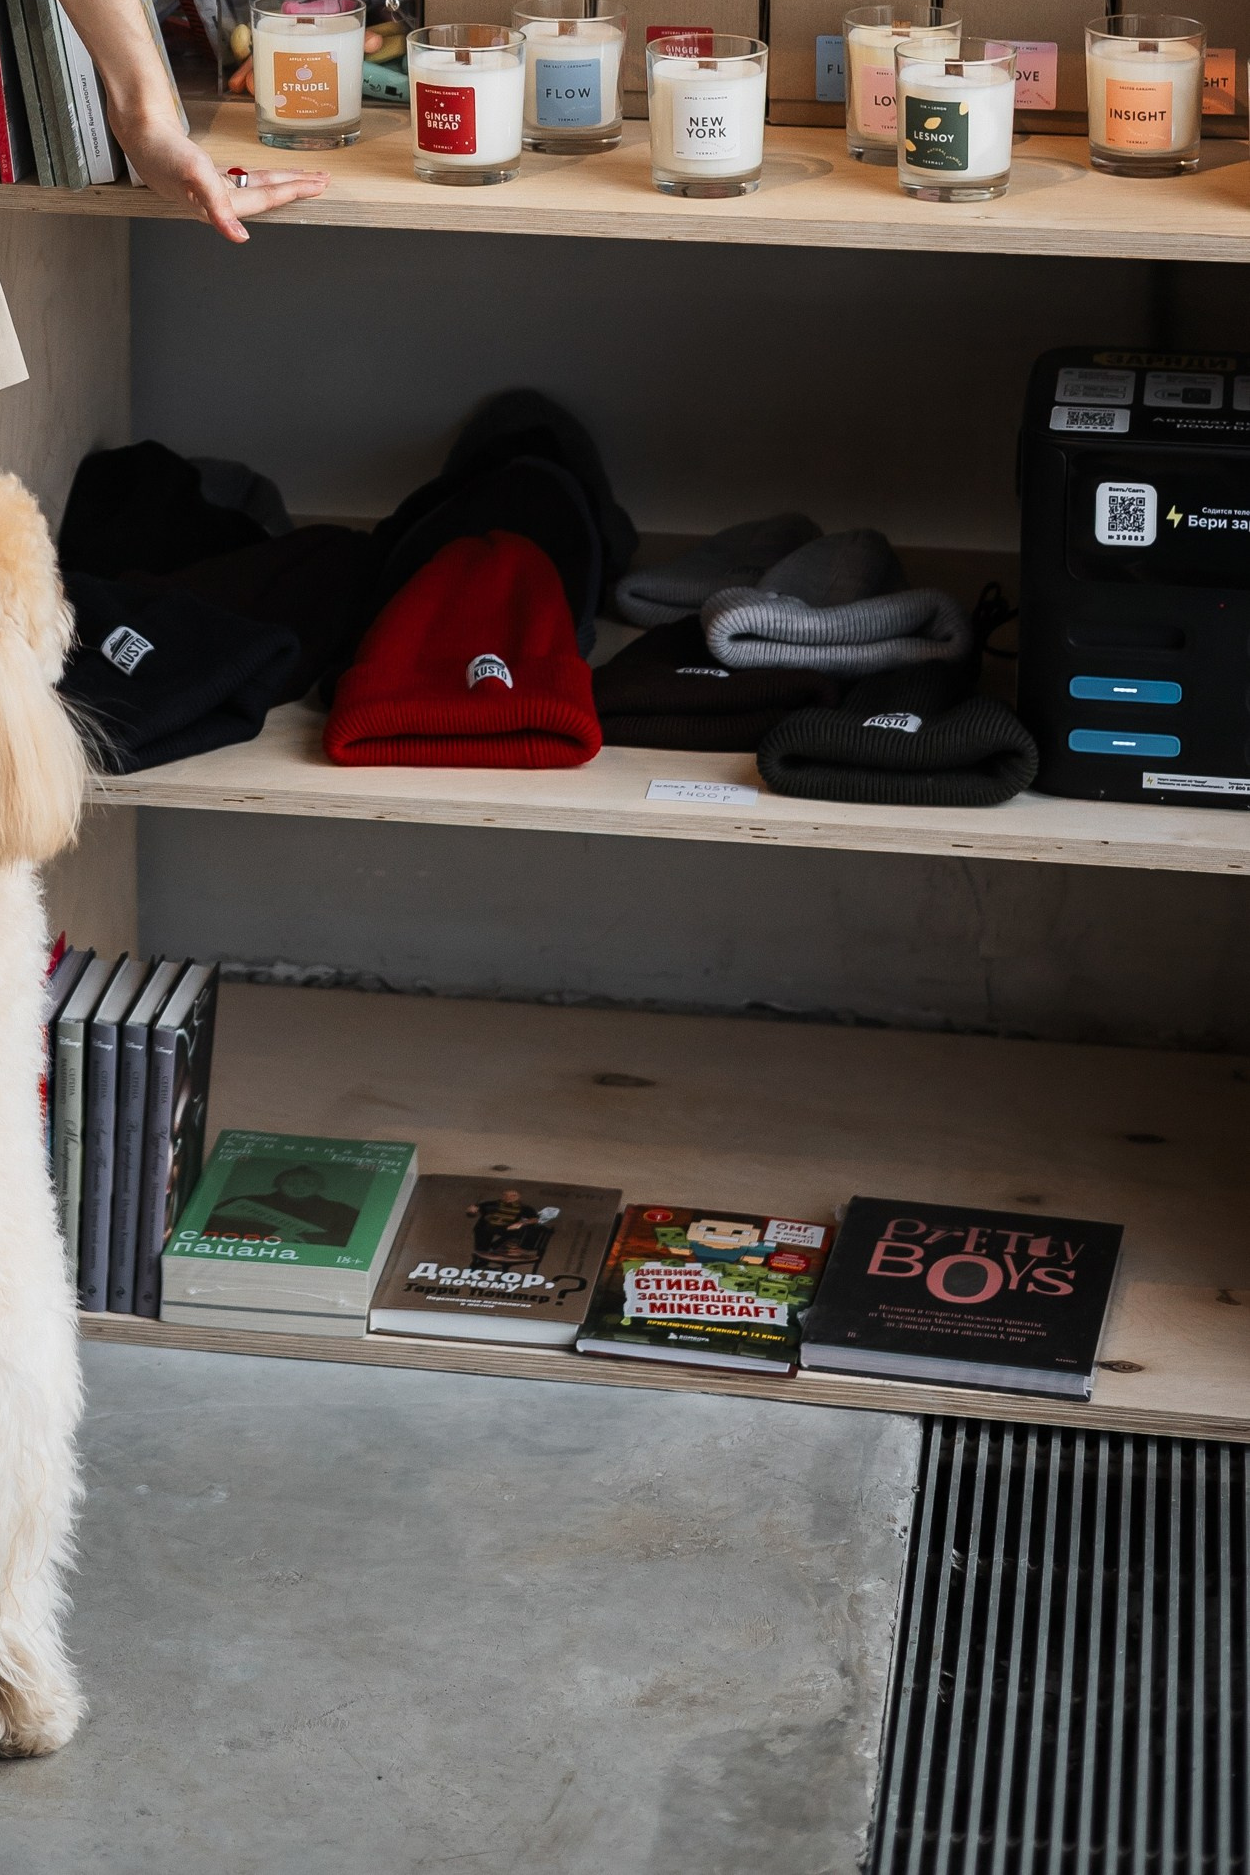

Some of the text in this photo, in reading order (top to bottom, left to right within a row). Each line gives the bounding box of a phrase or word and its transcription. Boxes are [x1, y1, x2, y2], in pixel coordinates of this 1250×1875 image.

[665, 45, 700, 55] GINGER
[827, 64, 843, 75] FL
[282, 82, 330, 92] STRUDEL
[546, 87, 591, 99] FLOW
[424, 111, 462, 123] GINGER
[1109, 108, 1167, 122] INSIGHT
[427, 119, 460, 131] BREAD
[689, 116, 725, 127] NEW
[685, 127, 727, 139] YORK
[913, 130, 955, 143] LESNOY
[1187, 515, 1228, 531] Бери
[117, 637, 149, 669] KUSTO
[473, 665, 508, 682] KUSTO
[869, 717, 908, 728] KUSTO
[179, 1230, 283, 1246] слово
[173, 1241, 300, 1261] пацана
[336, 1255, 364, 1264] 18+
[408, 1261, 556, 1291] Доктор,
[634, 1268, 703, 1277] ДНЕВНИК
[866, 1239, 1077, 1304] BOYS
[438, 1277, 522, 1293] почему
[634, 1278, 725, 1293] СТИВА,
[637, 1293, 755, 1305] ЗАСТРЯВШЕГО
[649, 1303, 778, 1319] MINECRAFT
